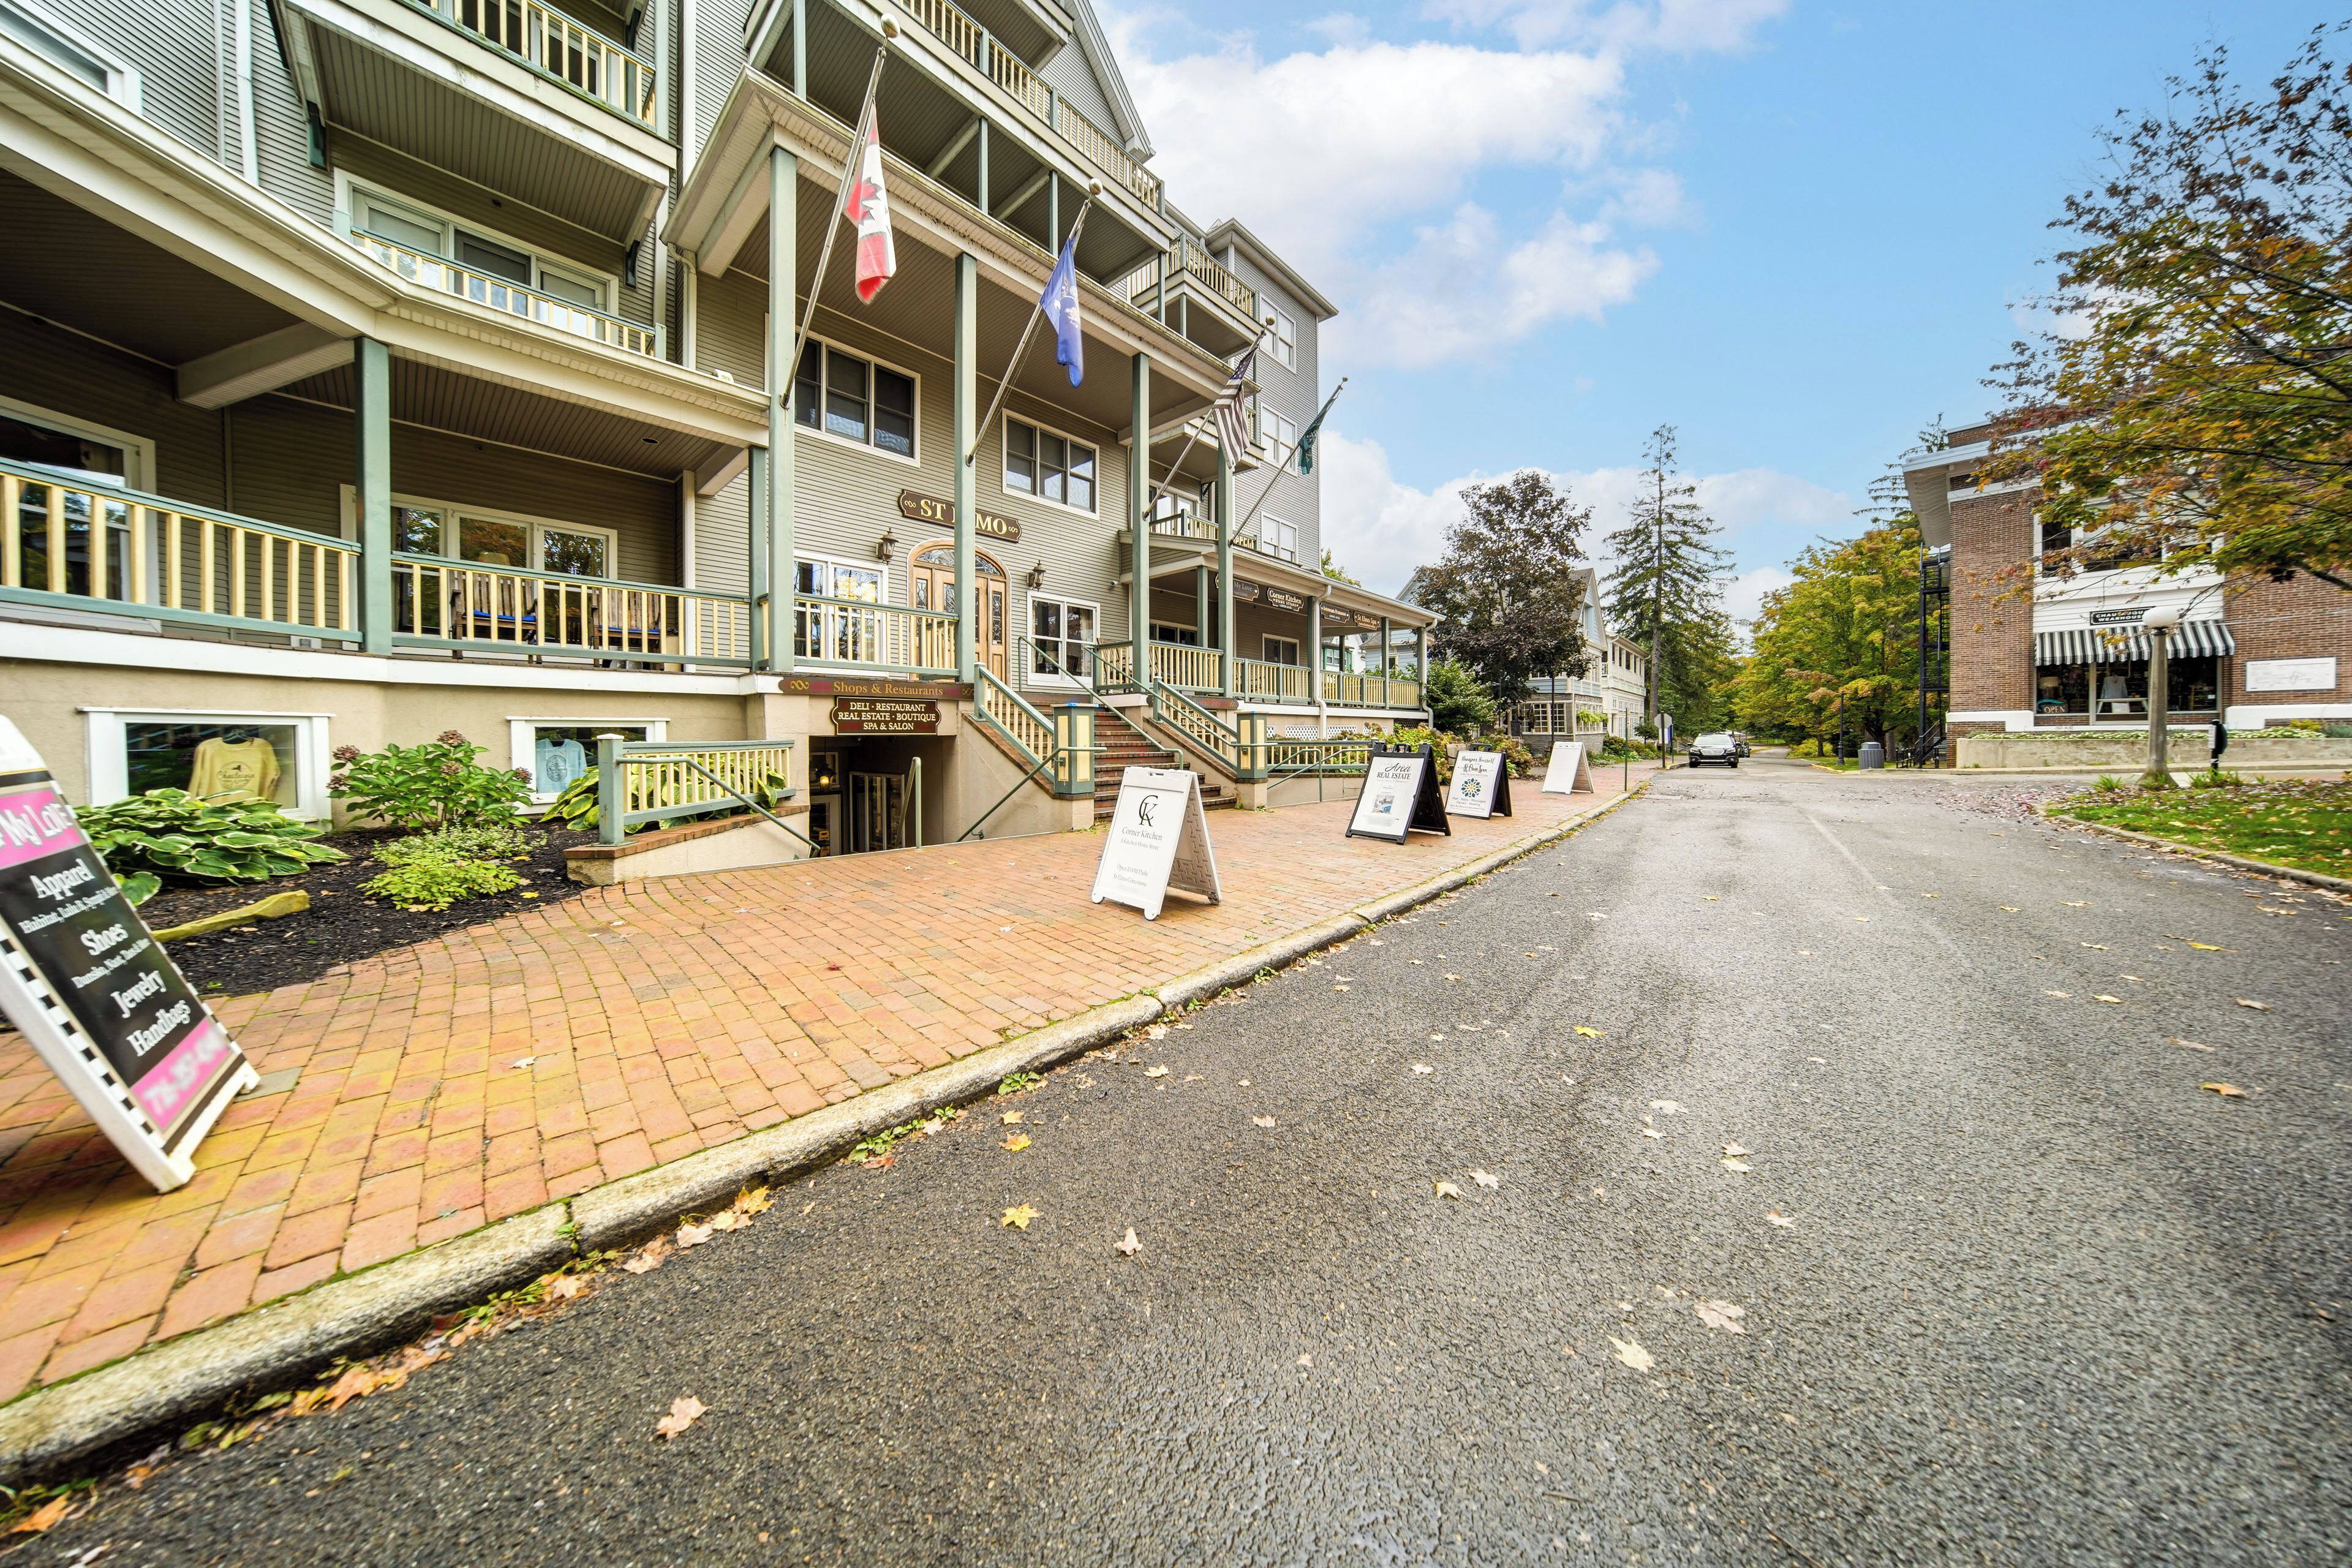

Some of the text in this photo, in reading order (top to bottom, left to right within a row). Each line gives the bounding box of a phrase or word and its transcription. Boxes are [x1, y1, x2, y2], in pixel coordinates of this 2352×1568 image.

[921, 499, 946, 520] ST
[1234, 581, 1253, 592] My Love
[1269, 590, 1302, 604] Corner Kitchen
[834, 681, 943, 695] Shops & Restaurants
[850, 702, 926, 712] DELI RESTAURANT
[838, 712, 860, 720] REAL
[896, 714, 936, 722] BOUTIQUE
[1385, 763, 1411, 772] Area
[1122, 827, 1163, 841] Corner Kitchen
[29, 858, 96, 900] Apparel
[80, 924, 129, 956] Shoes
[110, 970, 167, 1018] Jewelry
[126, 1000, 191, 1057] Handbags
